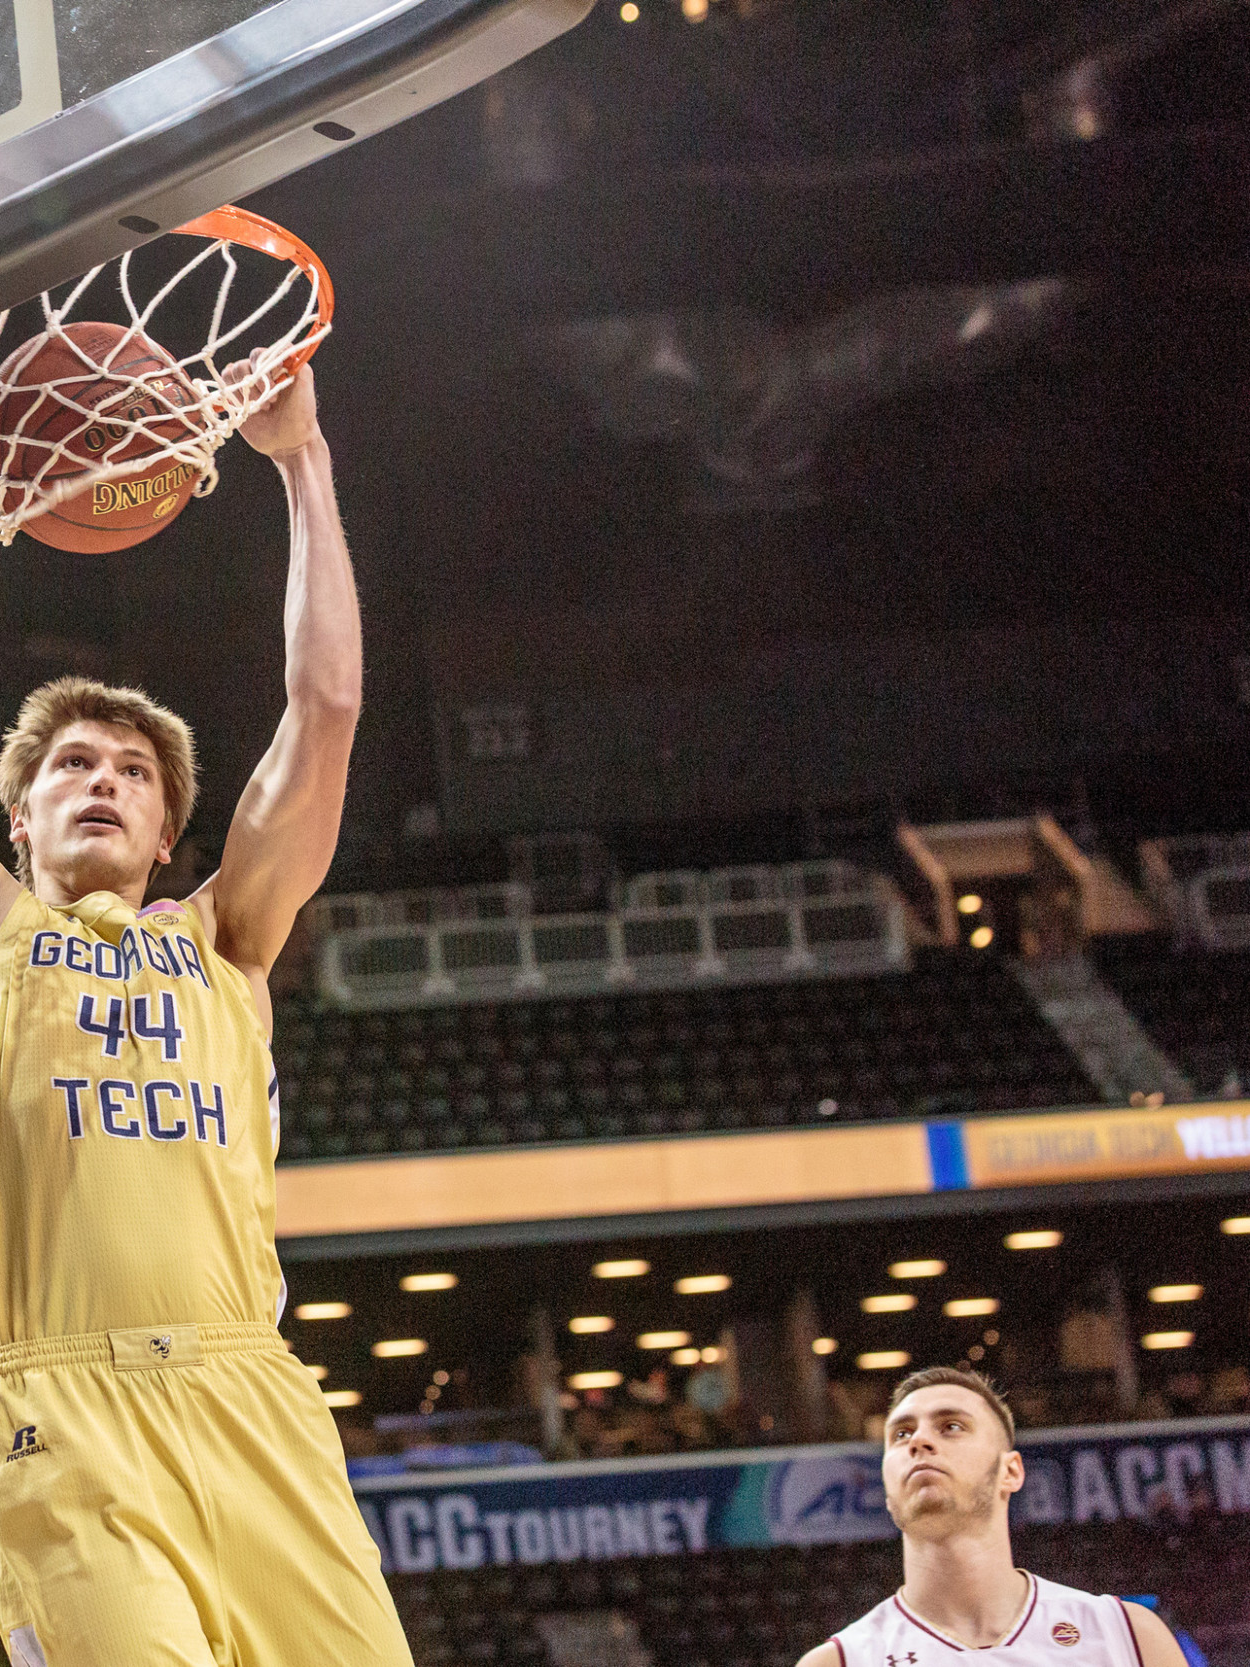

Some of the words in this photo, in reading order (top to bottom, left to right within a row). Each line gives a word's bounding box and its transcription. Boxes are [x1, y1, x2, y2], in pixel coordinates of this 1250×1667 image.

[28, 924, 212, 992] GEORGIA
[75, 989, 187, 1063] 44
[51, 1076, 228, 1149] TECH
[6, 1443, 48, 1463] RUSSELL
